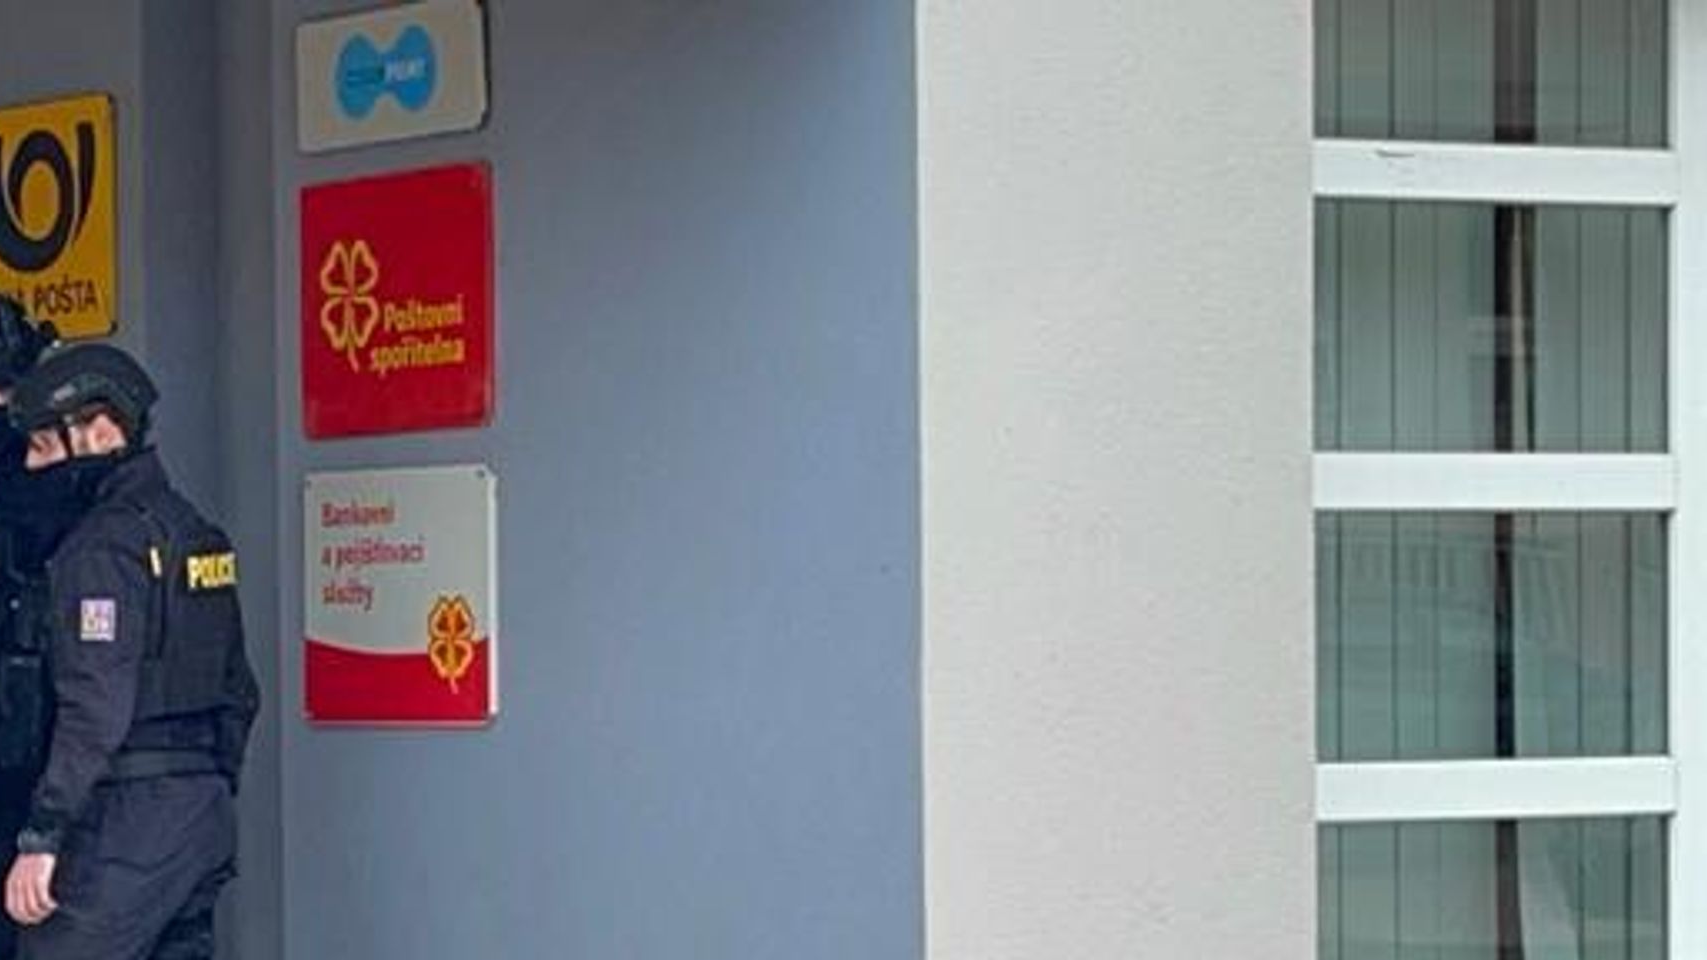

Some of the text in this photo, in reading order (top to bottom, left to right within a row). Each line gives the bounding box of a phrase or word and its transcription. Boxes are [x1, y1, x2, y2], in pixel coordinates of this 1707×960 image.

[34, 274, 97, 315] POŠTA
[382, 294, 463, 332] Poštovní
[370, 333, 464, 379] spořitelna
[321, 500, 395, 527] Bankovní
[321, 547, 331, 565] a
[322, 579, 375, 612] služby
